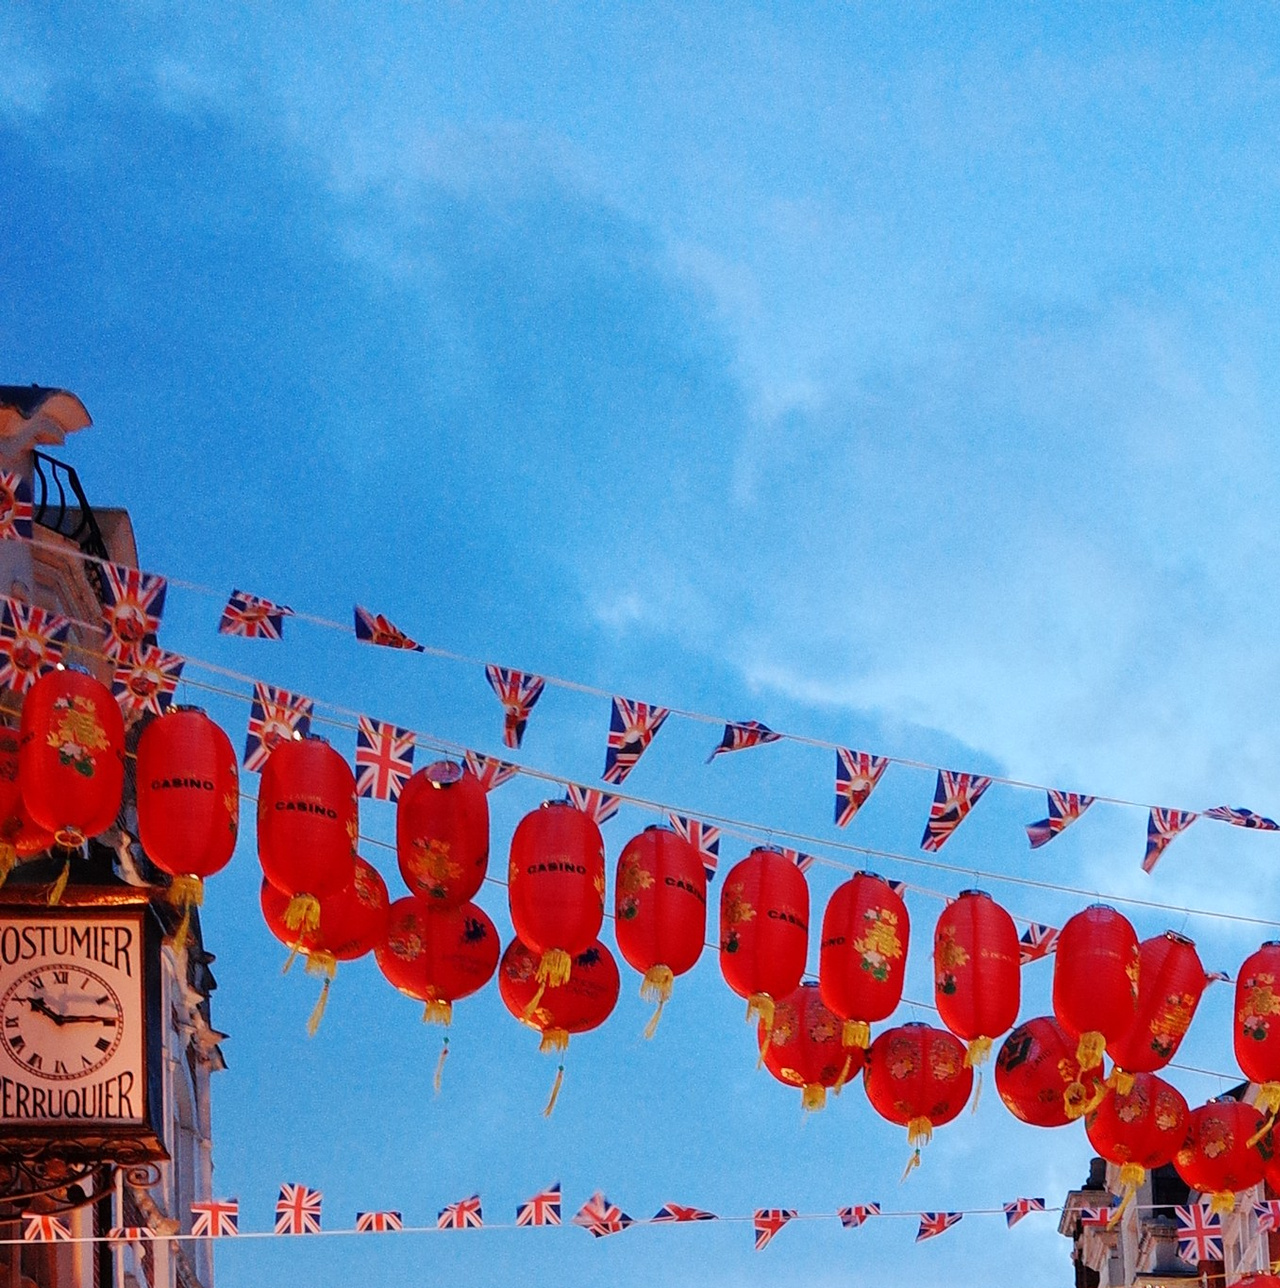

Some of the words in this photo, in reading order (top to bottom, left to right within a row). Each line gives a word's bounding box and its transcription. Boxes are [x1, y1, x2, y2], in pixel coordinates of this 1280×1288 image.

[152, 777, 214, 791] CASINO
[275, 801, 338, 819] CASINO
[527, 862, 587, 875] CASINO
[0, 926, 132, 977] OSTUMIER
[0, 1071, 134, 1118] ERRUQUIER
